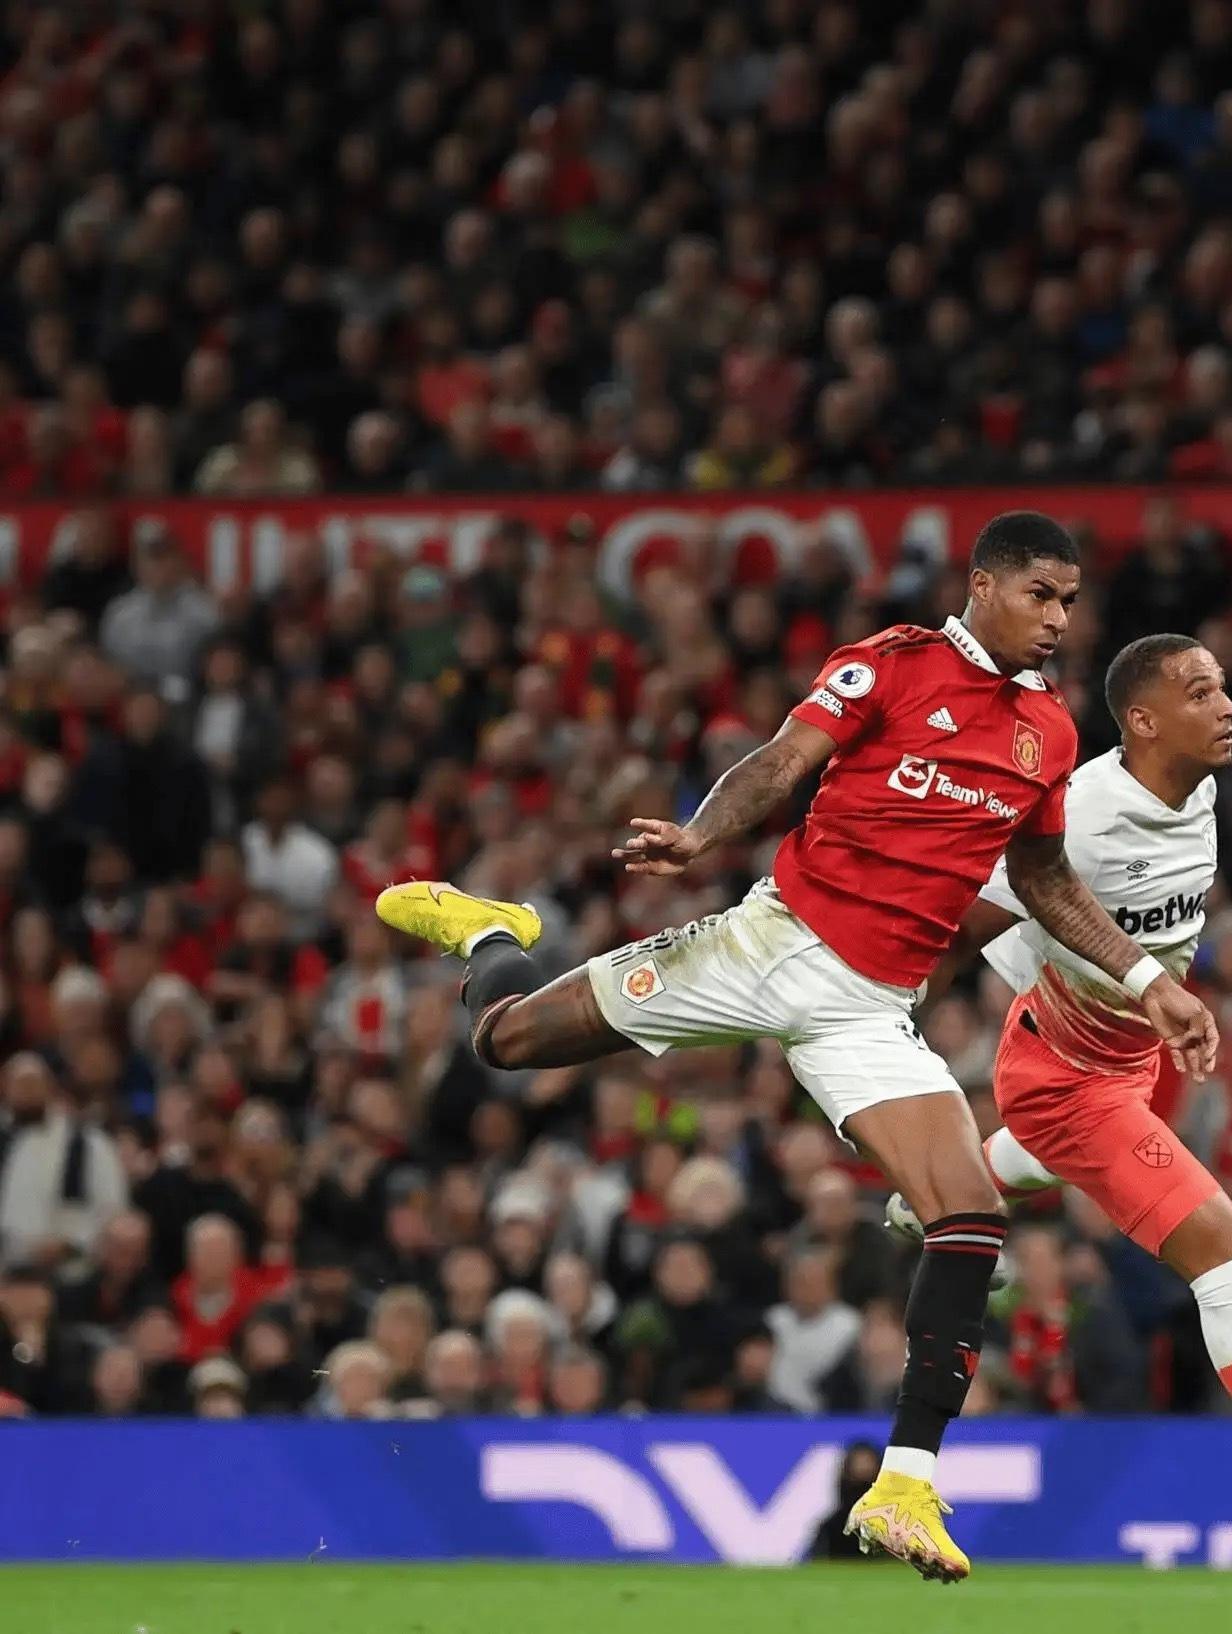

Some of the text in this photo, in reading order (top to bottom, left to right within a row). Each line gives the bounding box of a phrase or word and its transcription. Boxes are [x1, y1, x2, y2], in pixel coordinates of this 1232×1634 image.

[926, 717, 958, 733] adidas
[935, 772, 1019, 824] TeamView
[1115, 892, 1204, 936] betw
